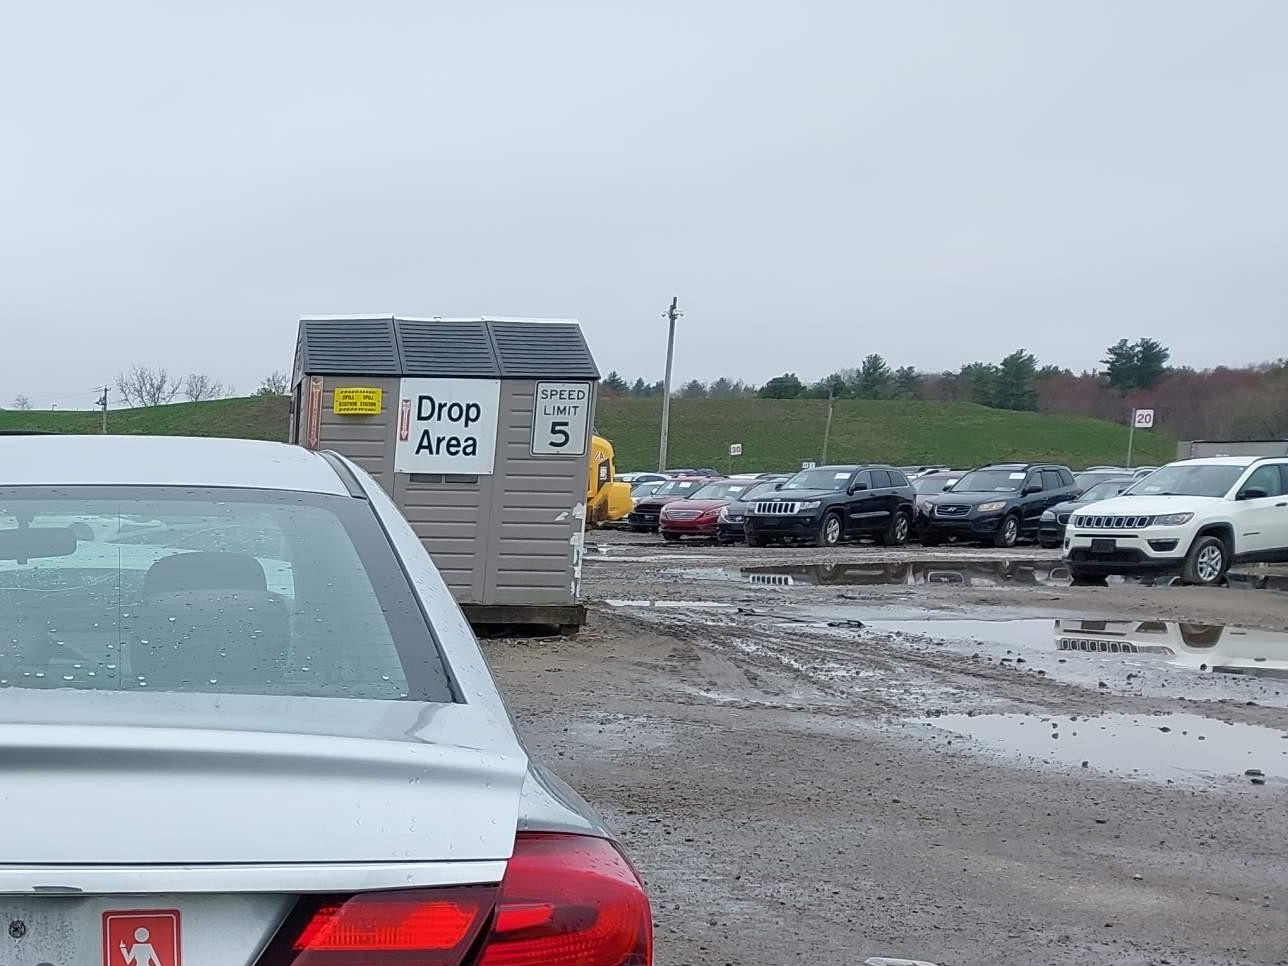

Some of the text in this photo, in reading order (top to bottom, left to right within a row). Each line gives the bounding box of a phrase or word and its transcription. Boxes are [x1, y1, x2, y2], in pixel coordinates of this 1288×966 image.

[540, 389, 586, 400] SPEED
[416, 394, 482, 428] Drop
[543, 405, 580, 416] LIMIT
[1137, 413, 1152, 424] 20
[414, 429, 478, 456] Area
[548, 421, 570, 448] 5
